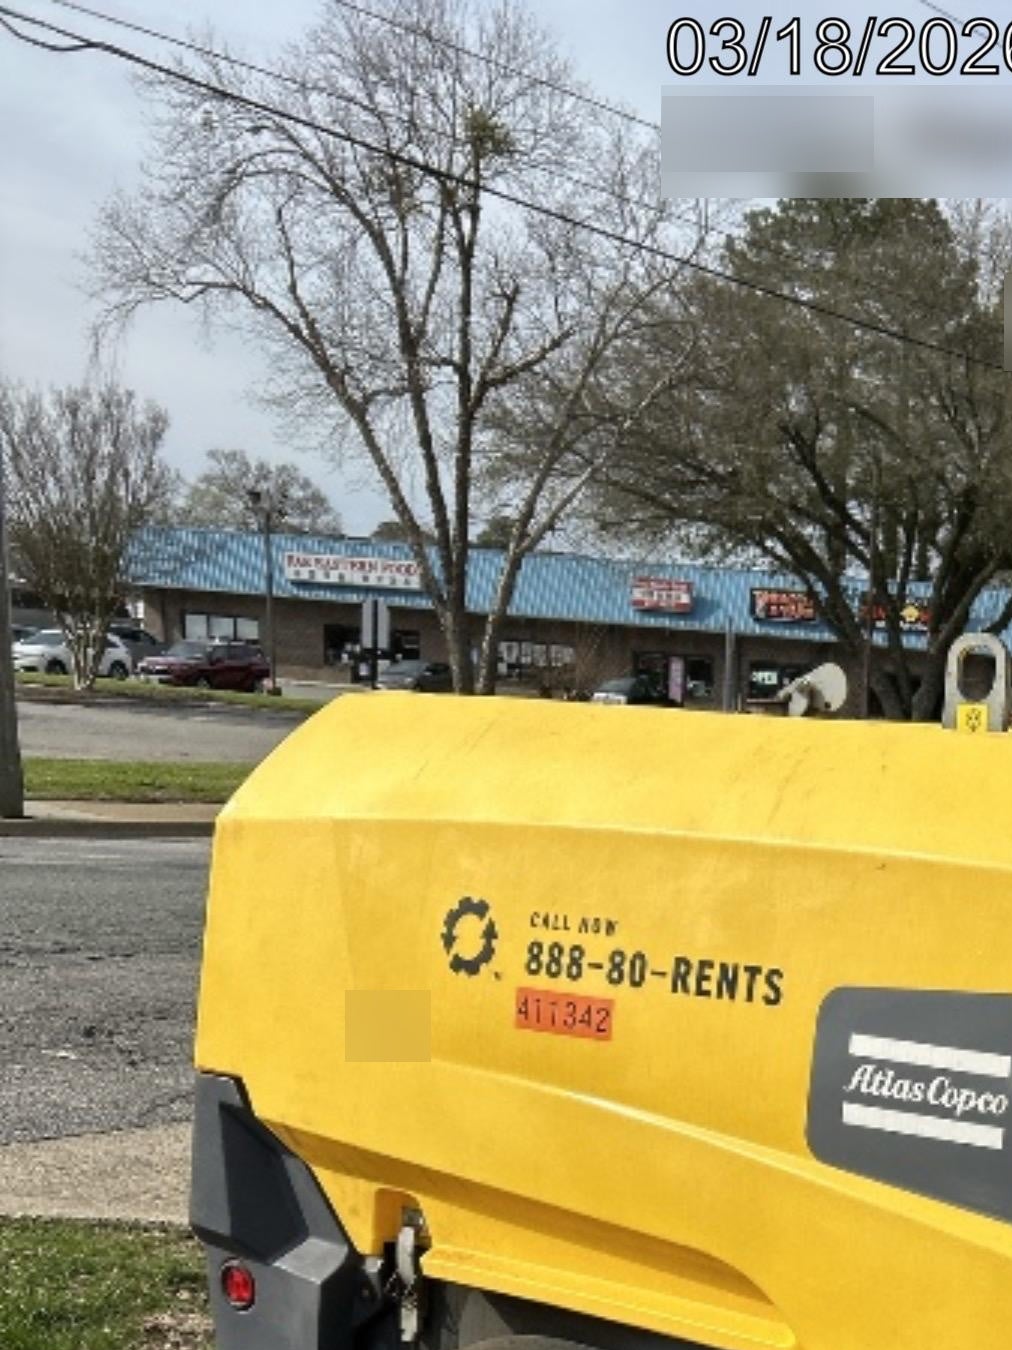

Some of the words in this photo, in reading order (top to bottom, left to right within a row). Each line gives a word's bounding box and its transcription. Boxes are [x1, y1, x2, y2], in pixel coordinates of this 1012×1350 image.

[530, 911, 570, 931] CALL
[525, 940, 784, 1005] 888-80-RENTS
[843, 1063, 926, 1104] Atlas
[926, 1076, 1009, 1116] Copco
